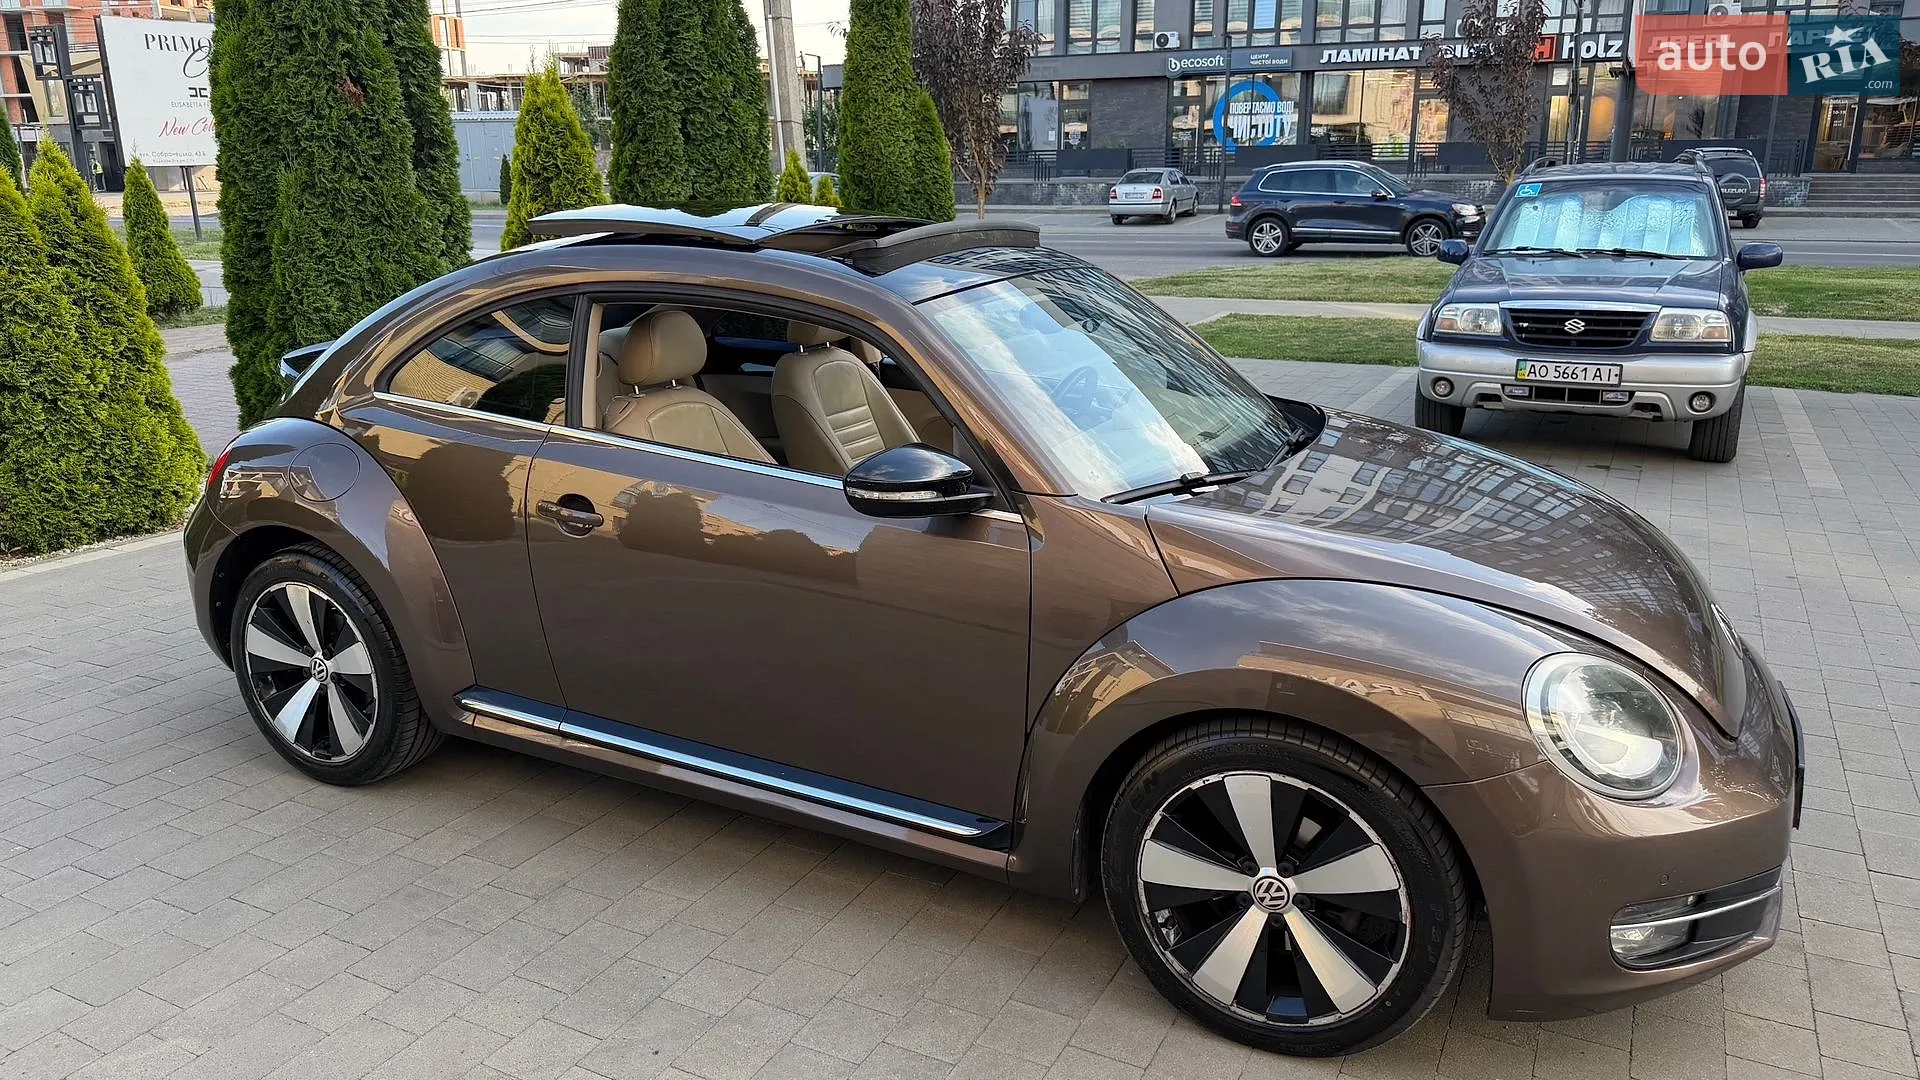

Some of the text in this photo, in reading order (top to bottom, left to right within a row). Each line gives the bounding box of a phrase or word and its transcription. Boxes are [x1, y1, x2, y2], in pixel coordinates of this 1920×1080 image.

[1320, 46, 1423, 63] ЛАМІНАТ
[1562, 35, 1623, 59] holz
[1181, 55, 1224, 68] ecosoft
[159, 117, 190, 137] New
[1553, 365, 1588, 381] 5661
